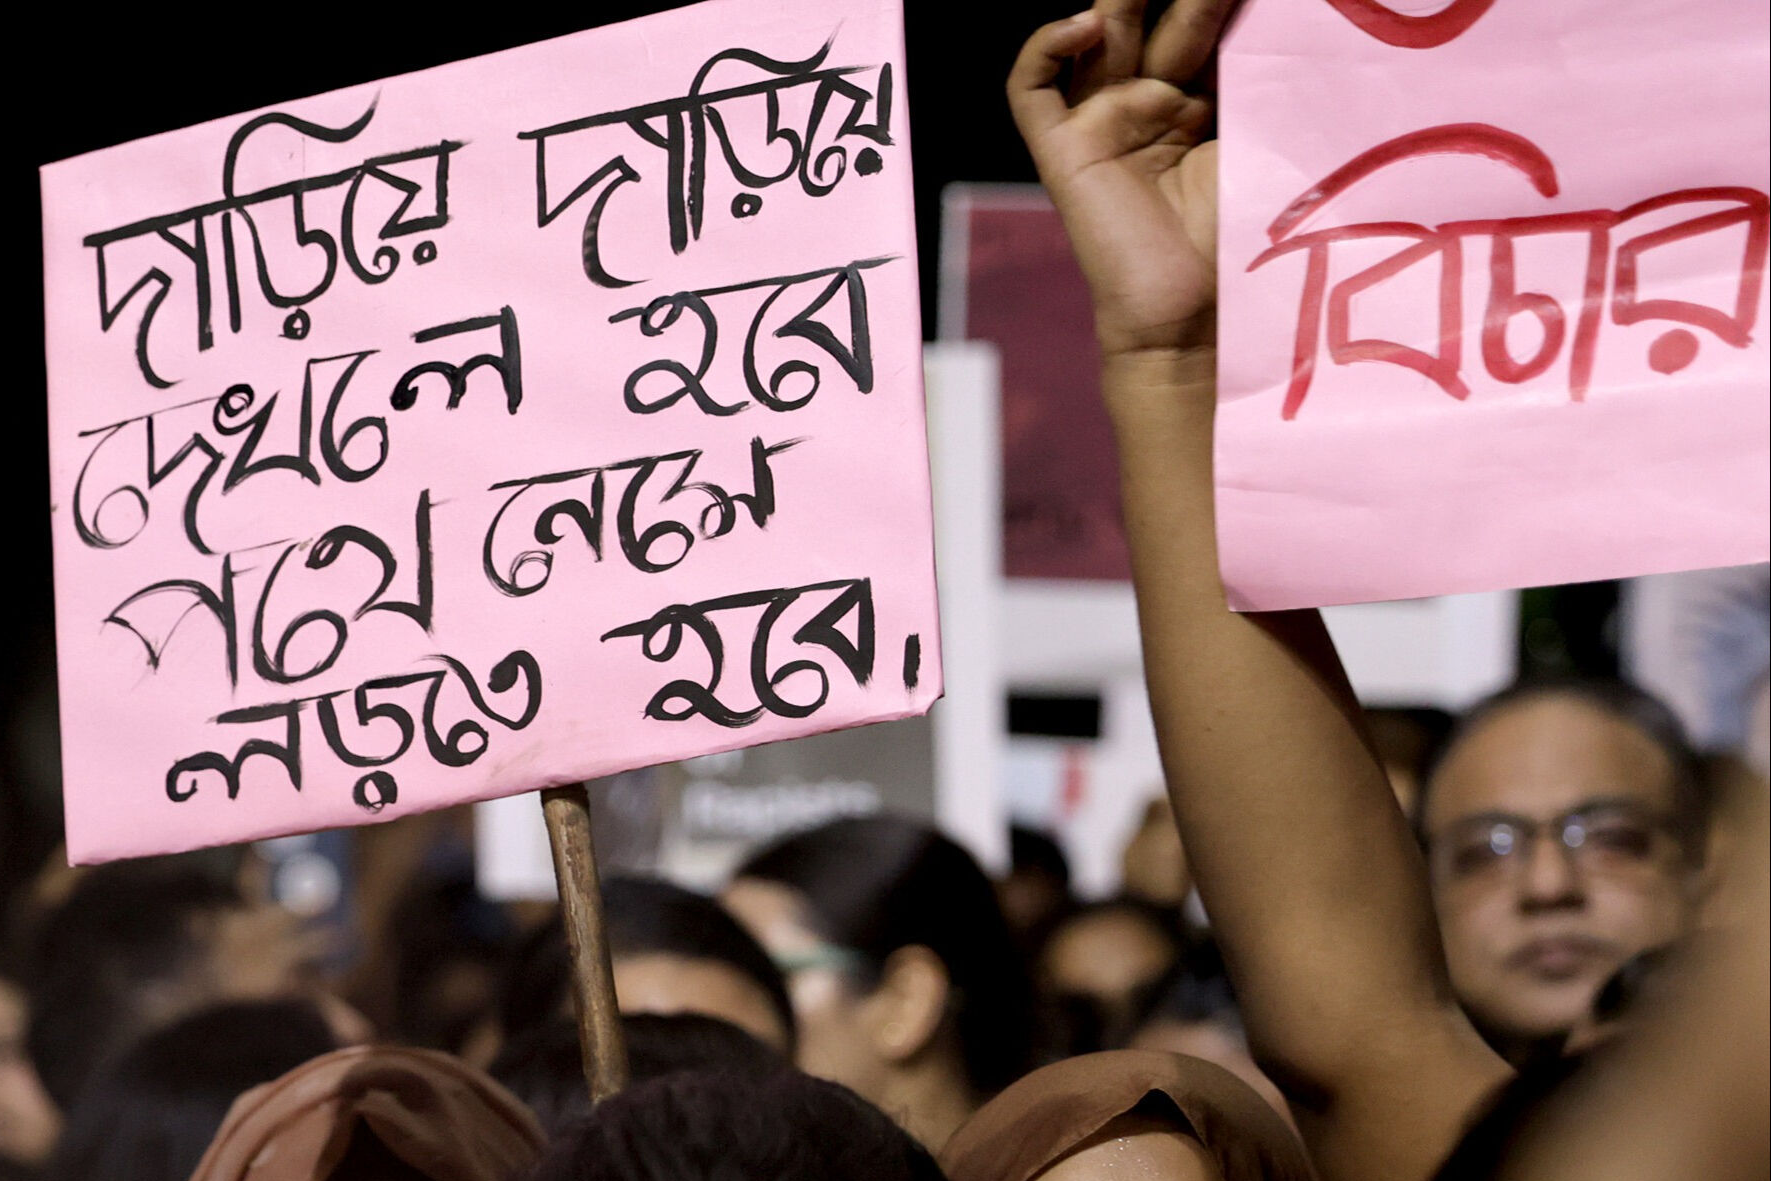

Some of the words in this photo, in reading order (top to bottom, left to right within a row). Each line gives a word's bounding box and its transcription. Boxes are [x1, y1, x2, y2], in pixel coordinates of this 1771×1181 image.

[73, 305, 524, 556] দেখলে
[608, 256, 904, 417] হবে
[1246, 121, 1771, 421] বিচার
[102, 487, 438, 690] পথে
[482, 436, 811, 598] নেমে
[165, 649, 544, 815] লড়তে
